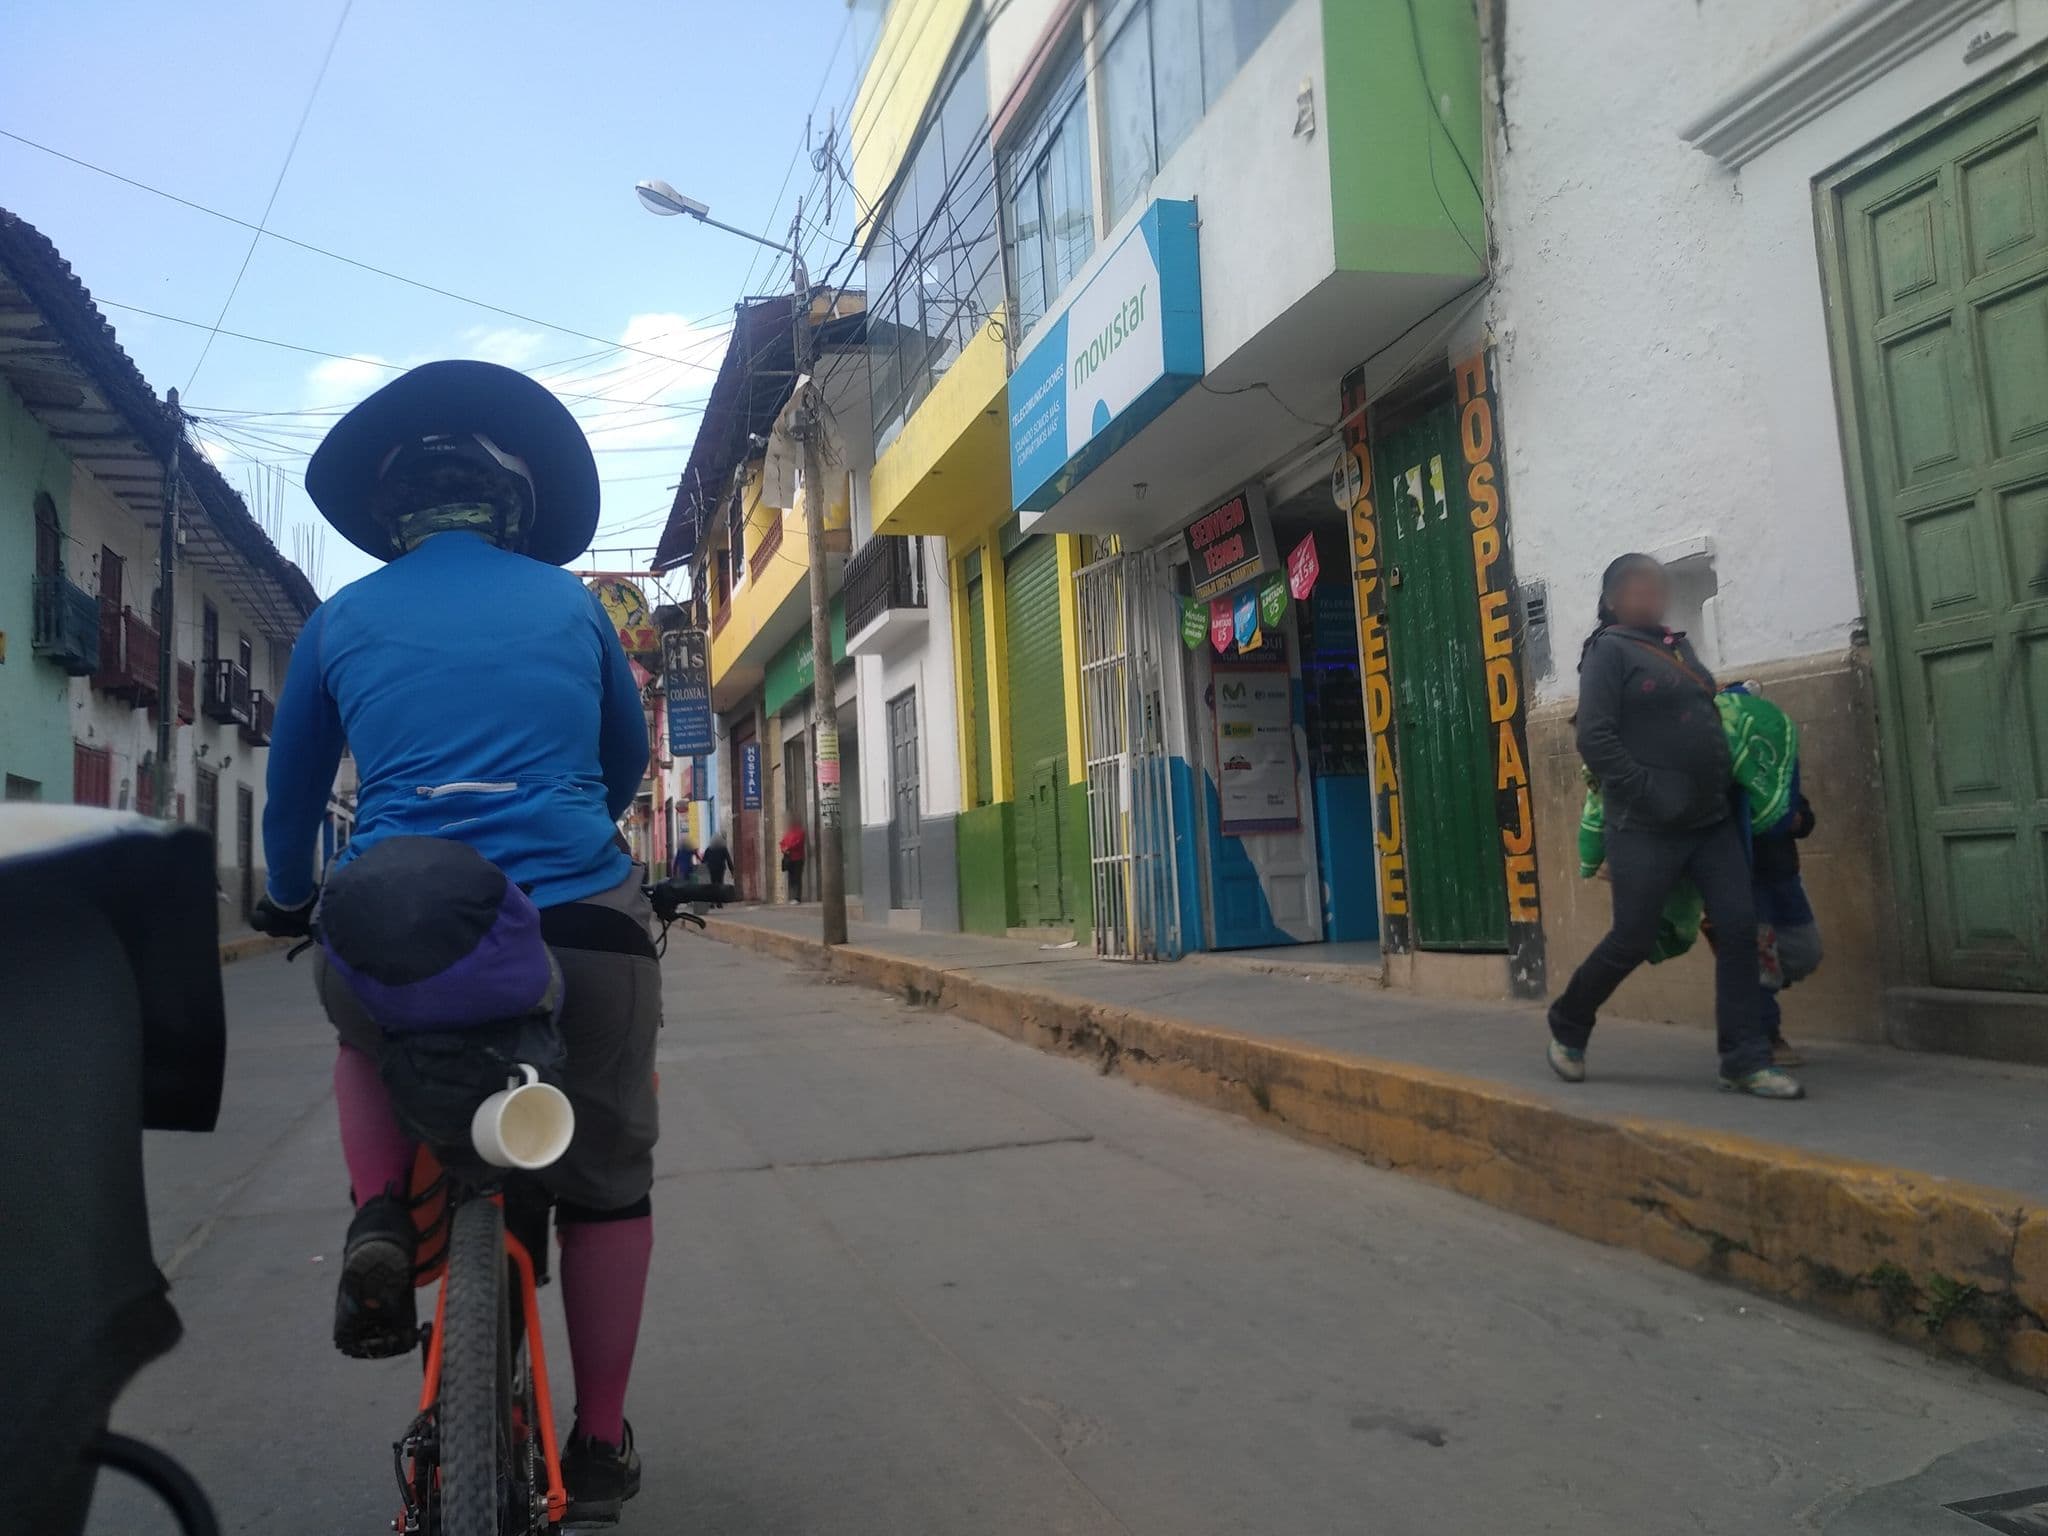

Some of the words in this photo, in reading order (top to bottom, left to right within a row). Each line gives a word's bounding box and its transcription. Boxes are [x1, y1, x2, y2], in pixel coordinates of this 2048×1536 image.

[1074, 284, 1146, 390] movistar
[1190, 497, 1245, 550] SERVICIO
[670, 687, 707, 702] COLONIAL
[747, 746, 756, 795] HOSTAL
